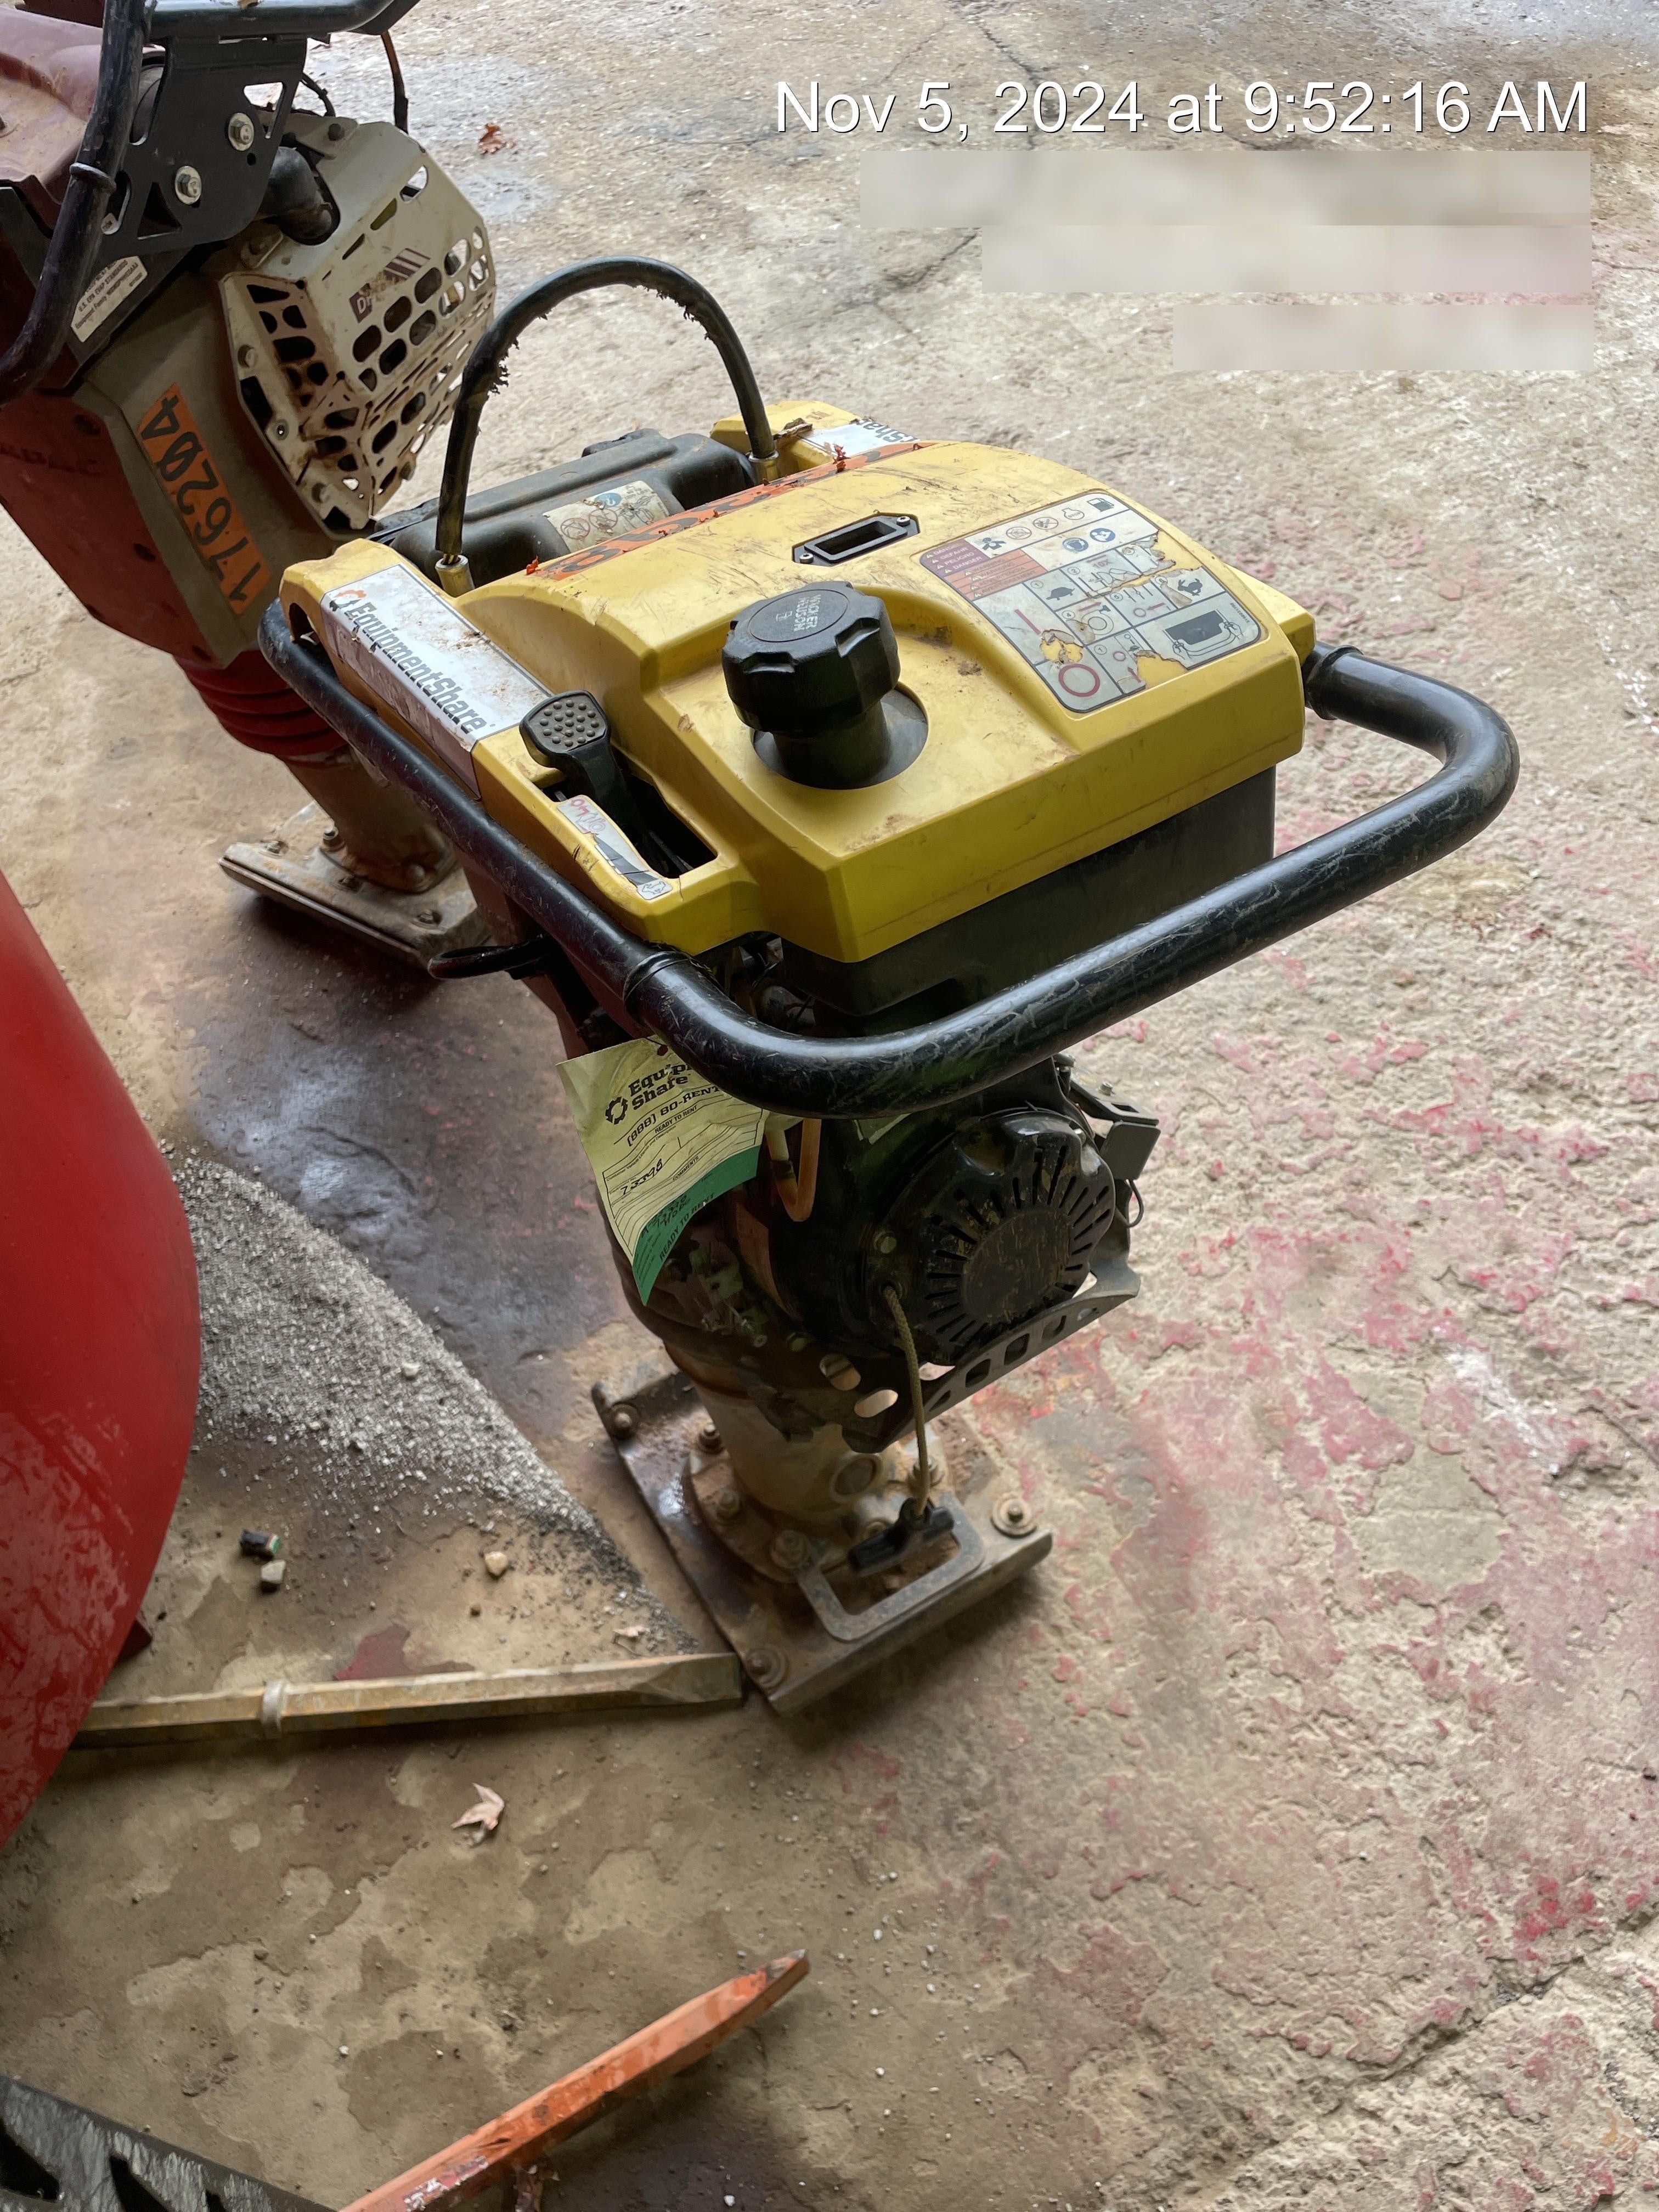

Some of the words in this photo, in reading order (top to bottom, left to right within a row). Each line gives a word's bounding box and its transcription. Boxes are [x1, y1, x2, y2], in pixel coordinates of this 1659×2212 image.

[141, 394, 262, 602] 176204
[953, 556, 983, 569] DANGER
[344, 602, 488, 735] EquipmentShare
[628, 1064, 692, 1097] Equip
[632, 1076, 688, 1110] Share
[654, 1119, 673, 1133] READY
[683, 1105, 697, 1118] RENT
[673, 1155, 699, 1181] COMMENTS
[659, 1226, 679, 1261] READY
[679, 1213, 689, 1226] TO
